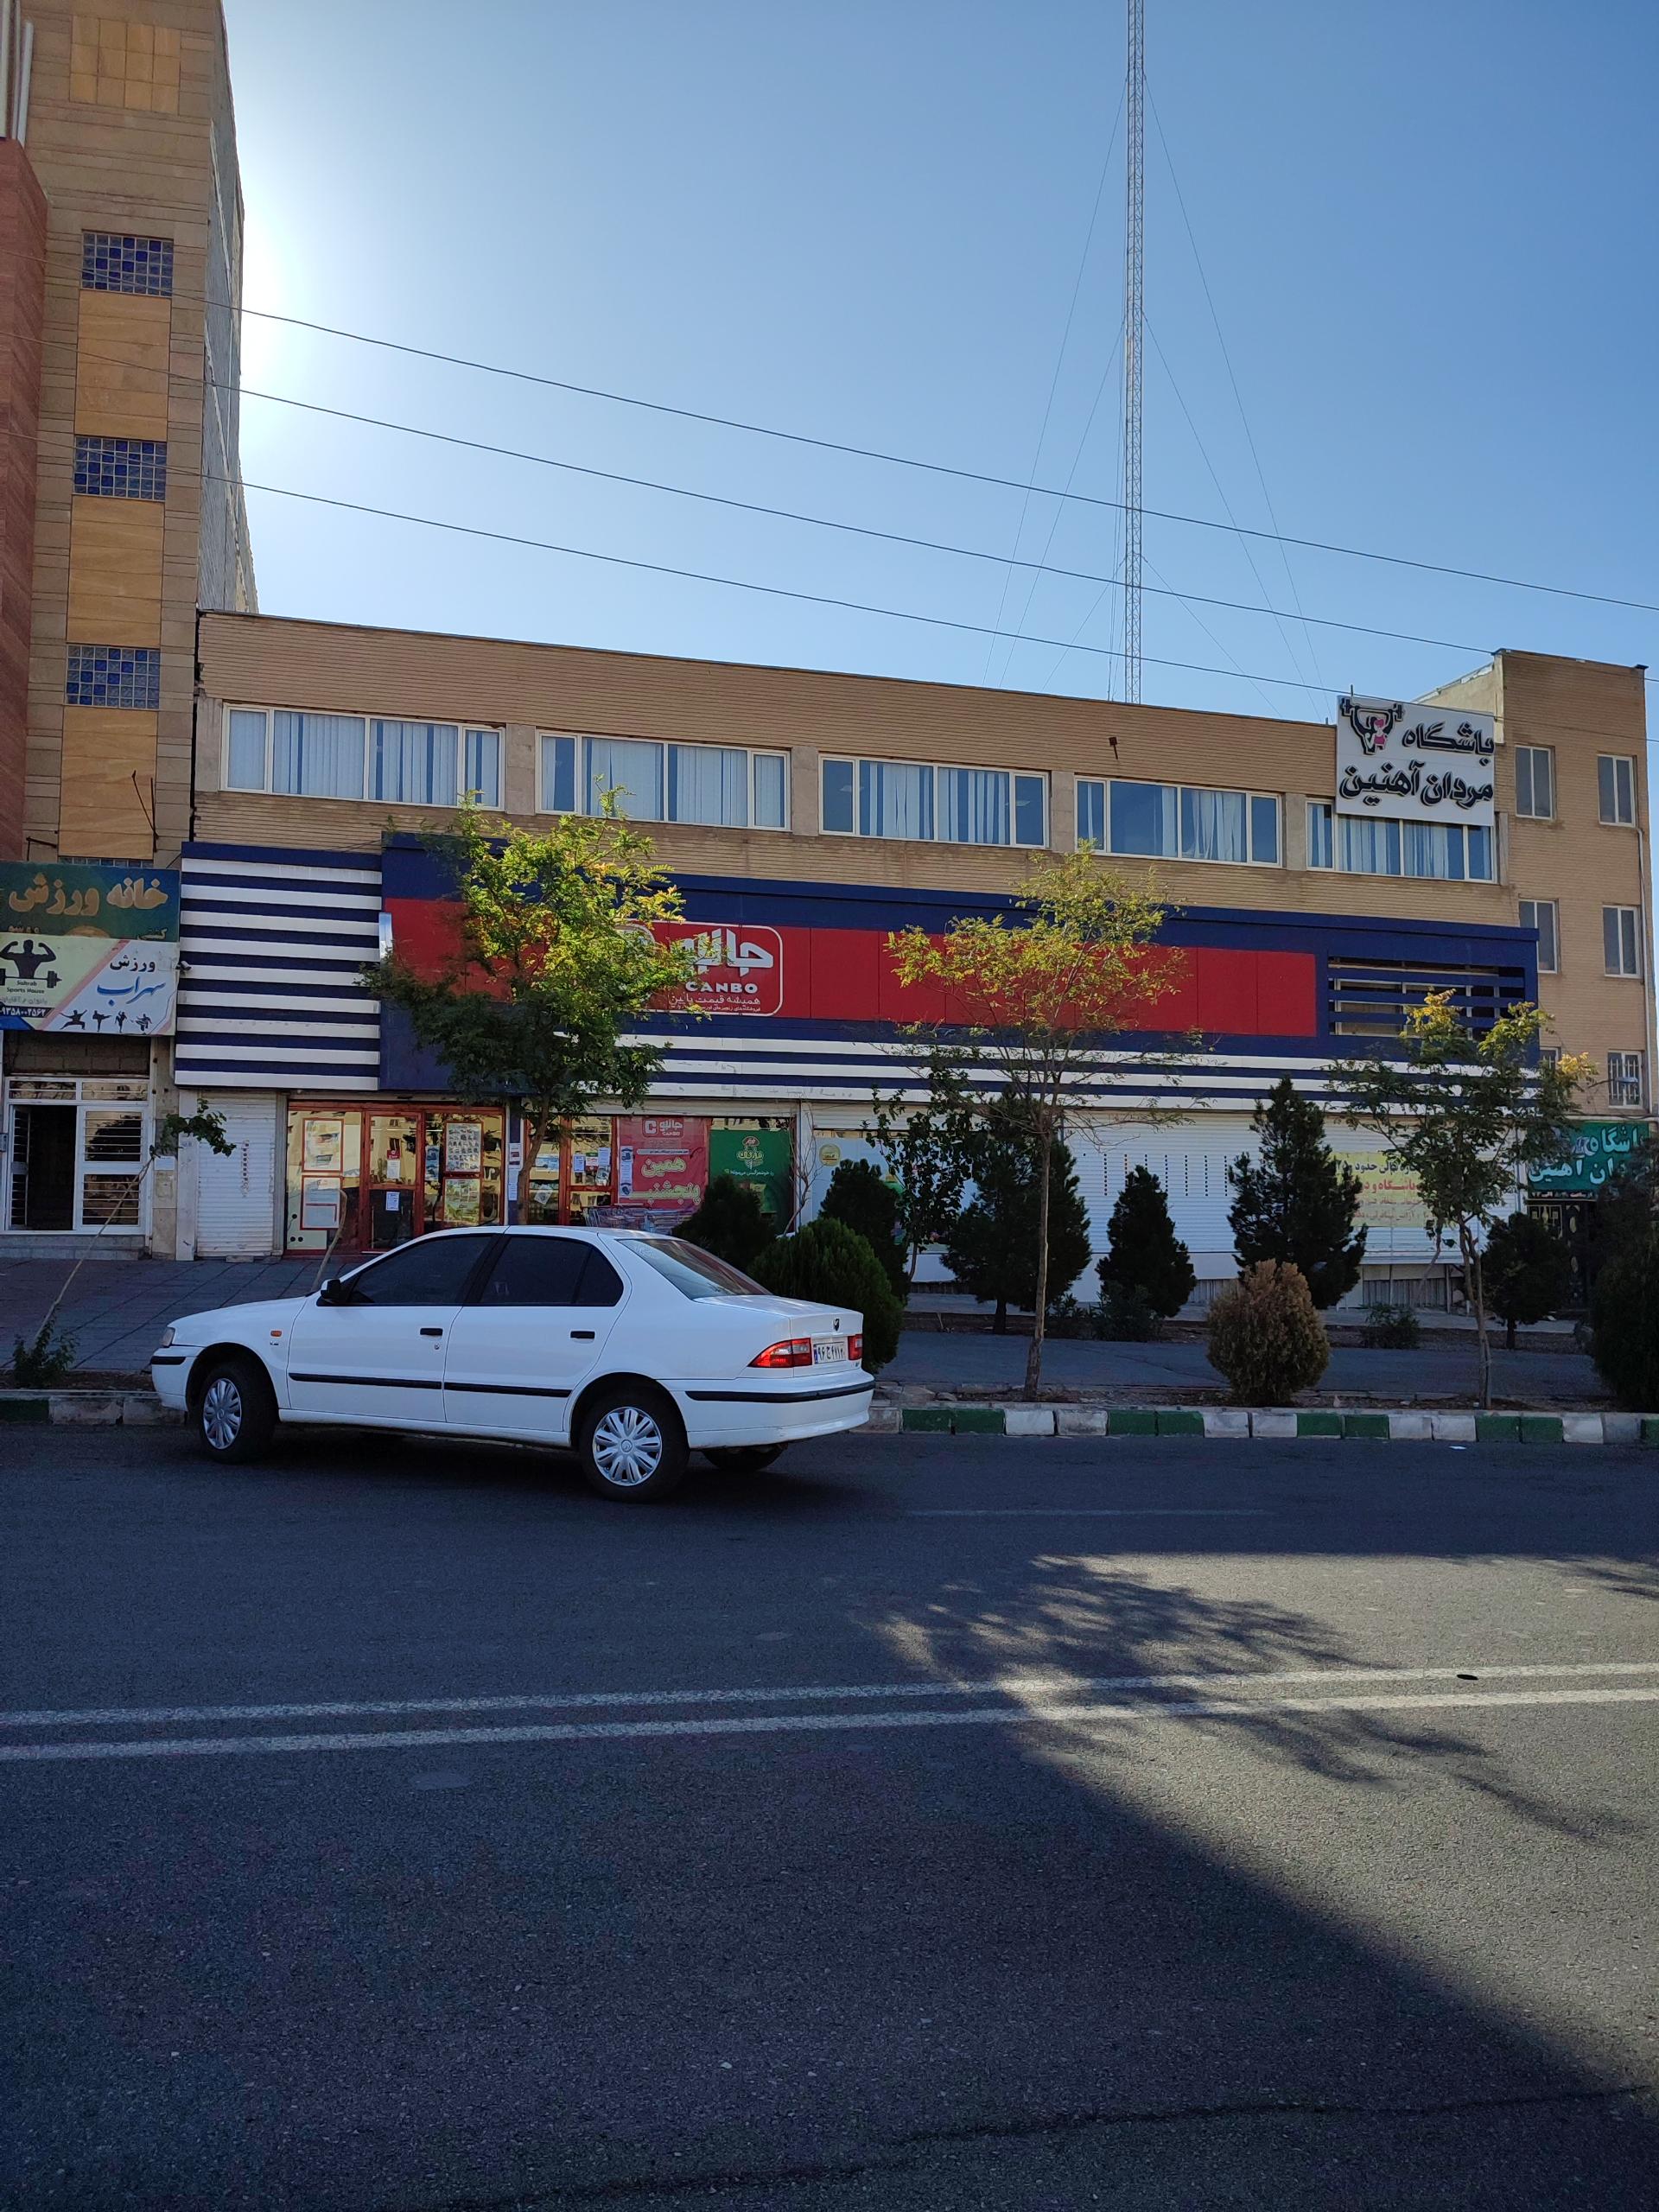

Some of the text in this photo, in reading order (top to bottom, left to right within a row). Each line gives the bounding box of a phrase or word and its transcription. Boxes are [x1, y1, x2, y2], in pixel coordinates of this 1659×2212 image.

[1402, 721, 1494, 766] باشگاه
[1338, 760, 1494, 810] مردان آهنین
[9, 872, 168, 916] خانه ورزش
[109, 954, 156, 973] ورزش
[685, 982, 759, 995] CANBO
[695, 993, 724, 1006] قیمت
[727, 995, 761, 1007] همیشه
[640, 1157, 687, 1178] همین
[629, 1179, 702, 1206] پنجشنب
